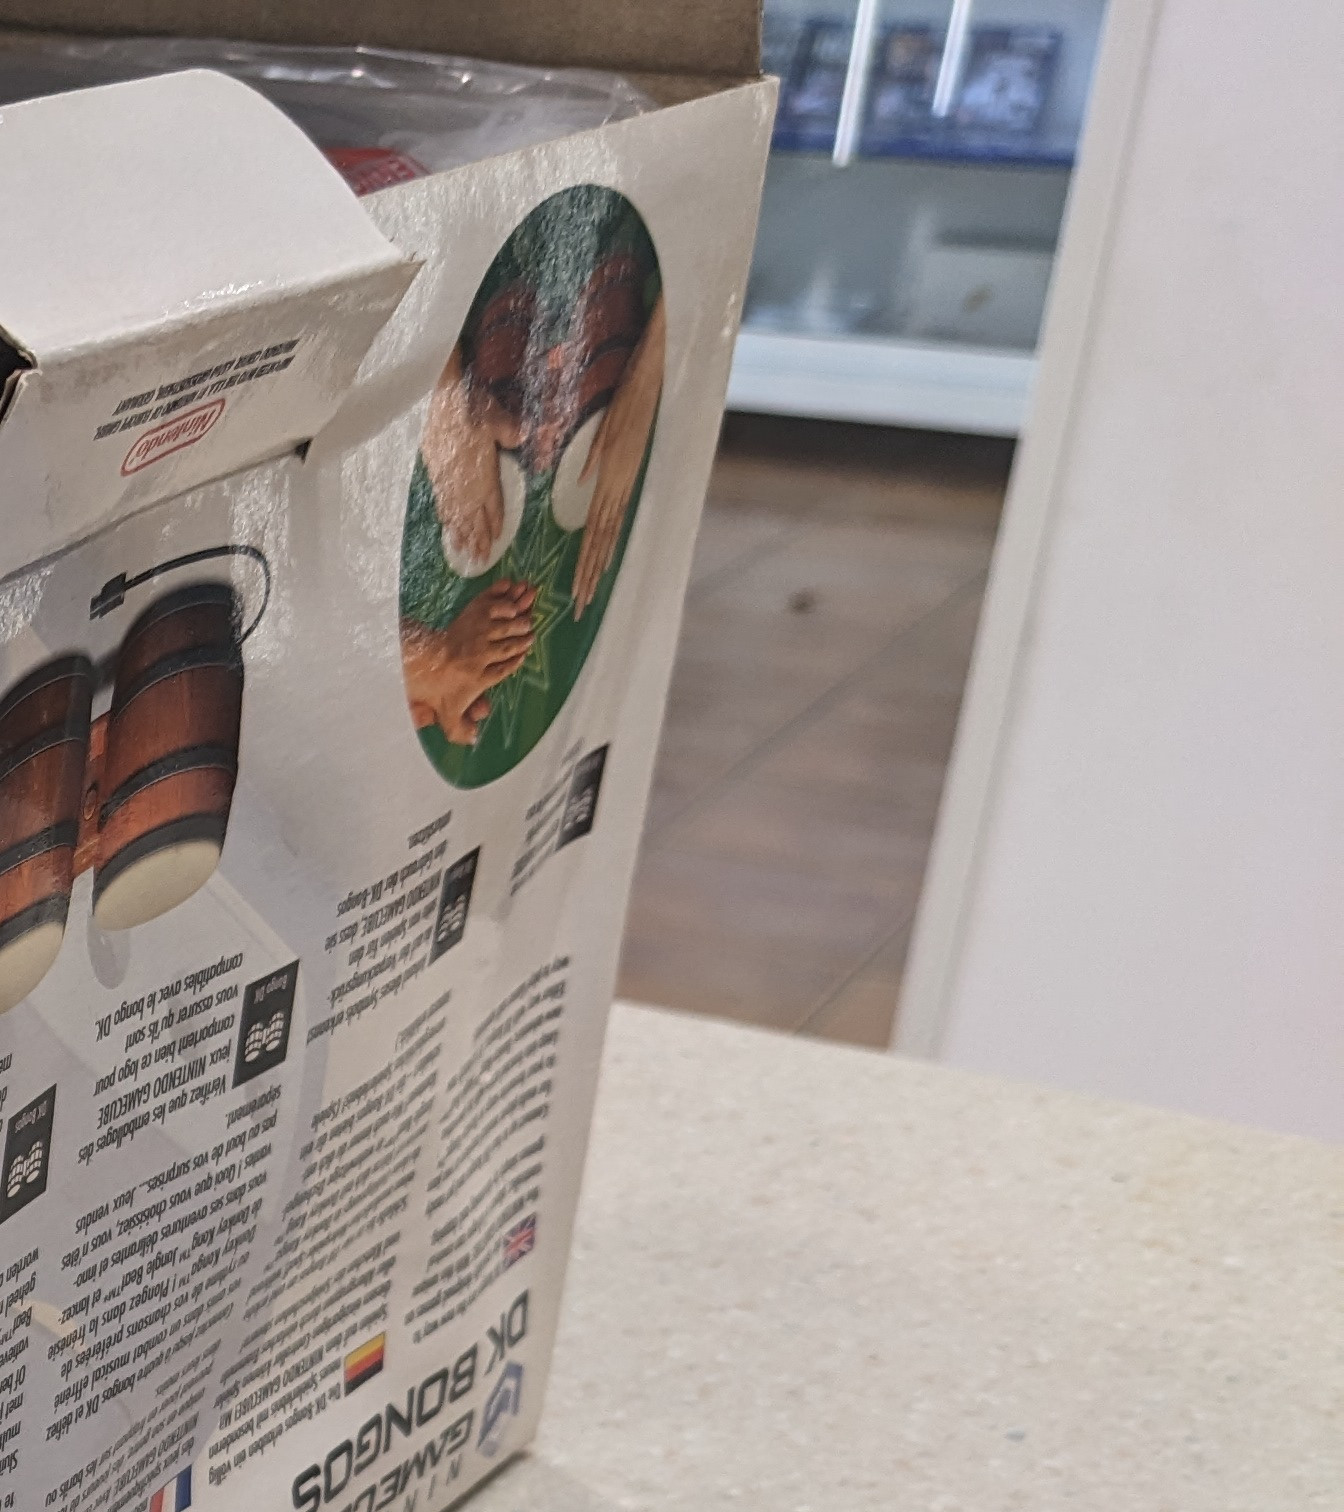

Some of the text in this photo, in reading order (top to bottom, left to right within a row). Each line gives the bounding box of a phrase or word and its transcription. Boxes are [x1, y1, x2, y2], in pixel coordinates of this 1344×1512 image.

[152, 1054, 207, 1099] NINTENDO
[95, 1081, 151, 1130] GAMECUBE
[483, 1286, 529, 1378] DK
